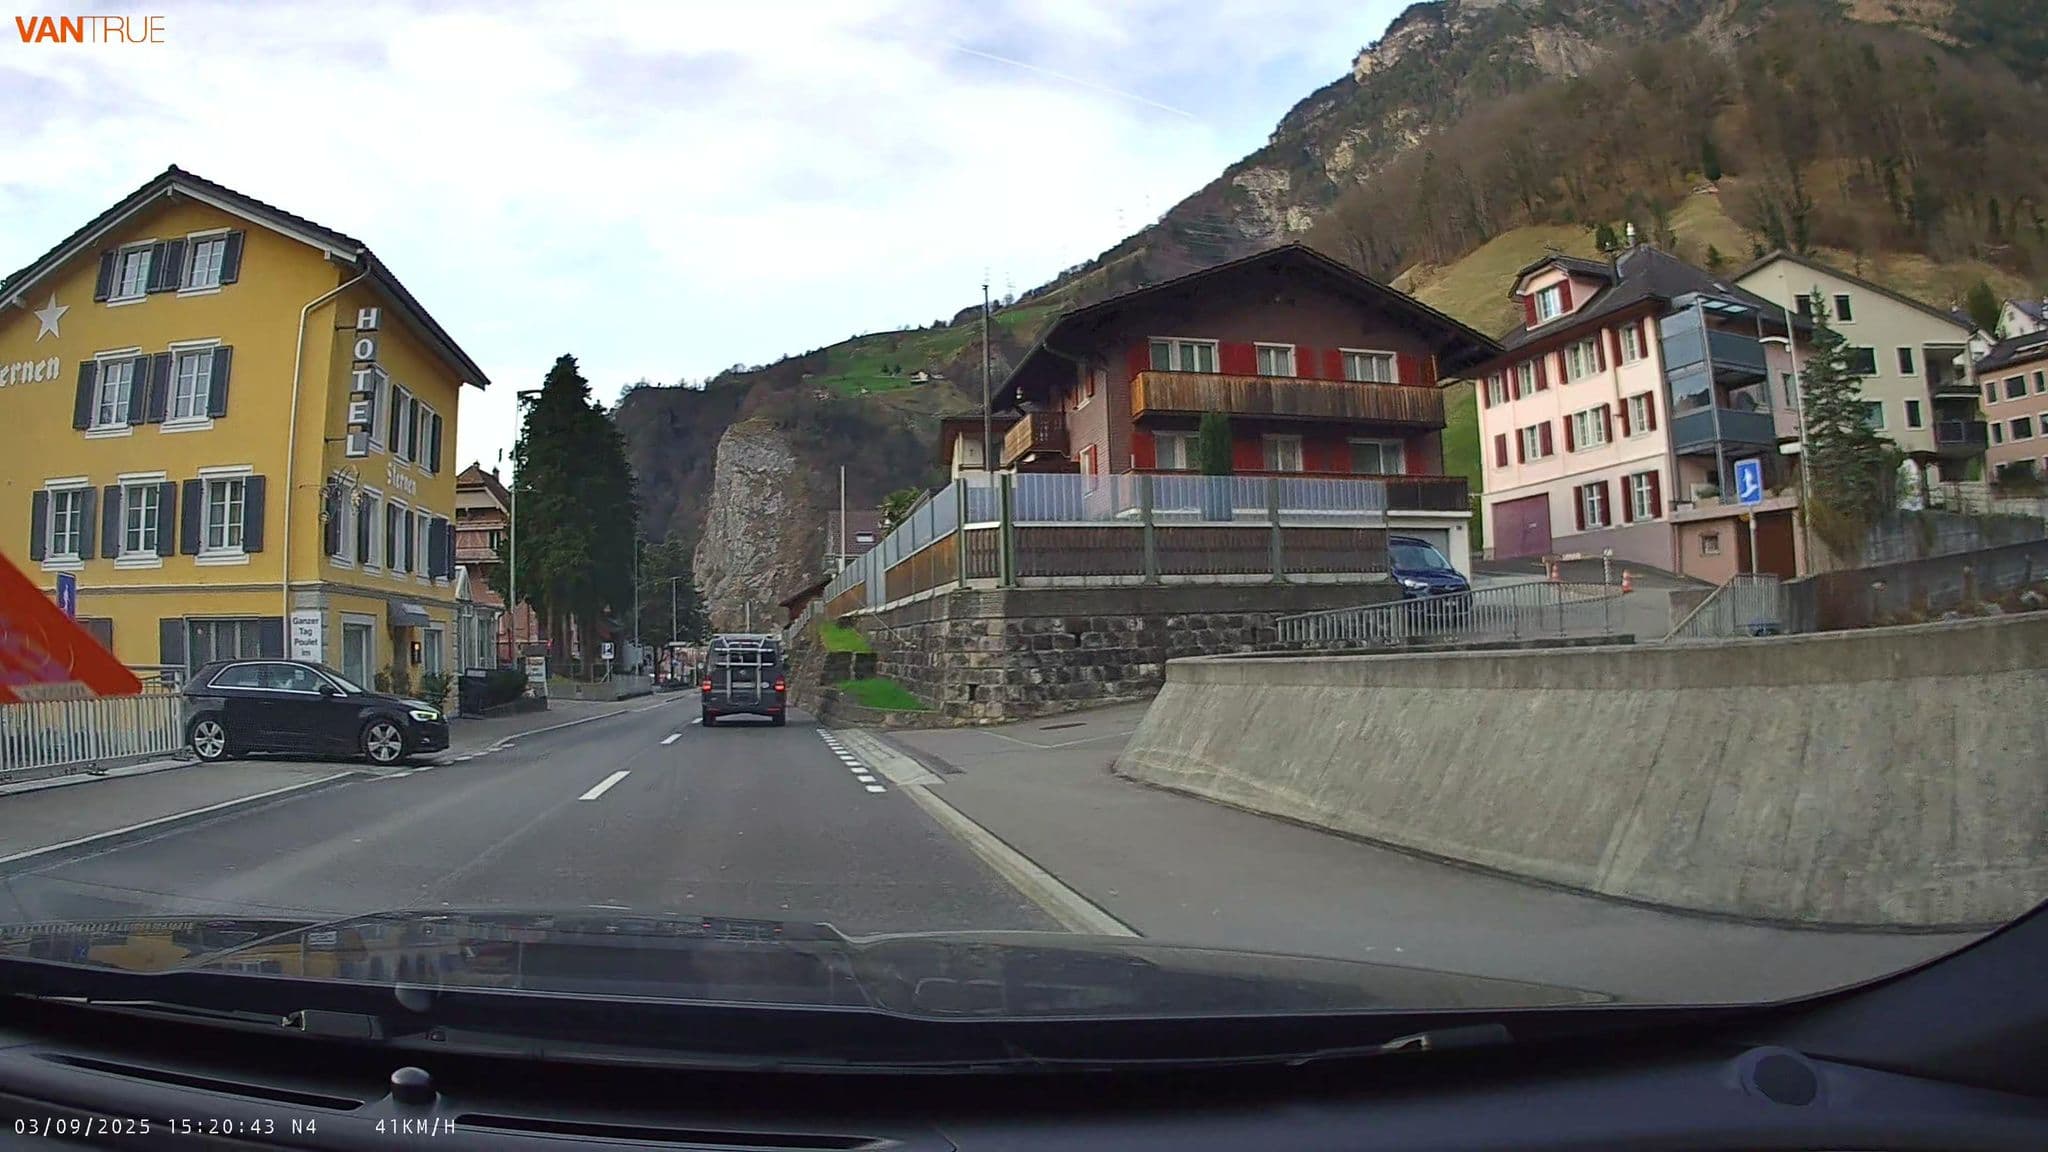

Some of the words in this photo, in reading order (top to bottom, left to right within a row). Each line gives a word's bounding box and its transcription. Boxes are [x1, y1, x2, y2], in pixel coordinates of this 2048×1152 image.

[346, 308, 377, 456] HOTEL
[292, 616, 319, 625] Ganzer
[299, 627, 313, 637] Tag
[294, 637, 318, 646] Poulet
